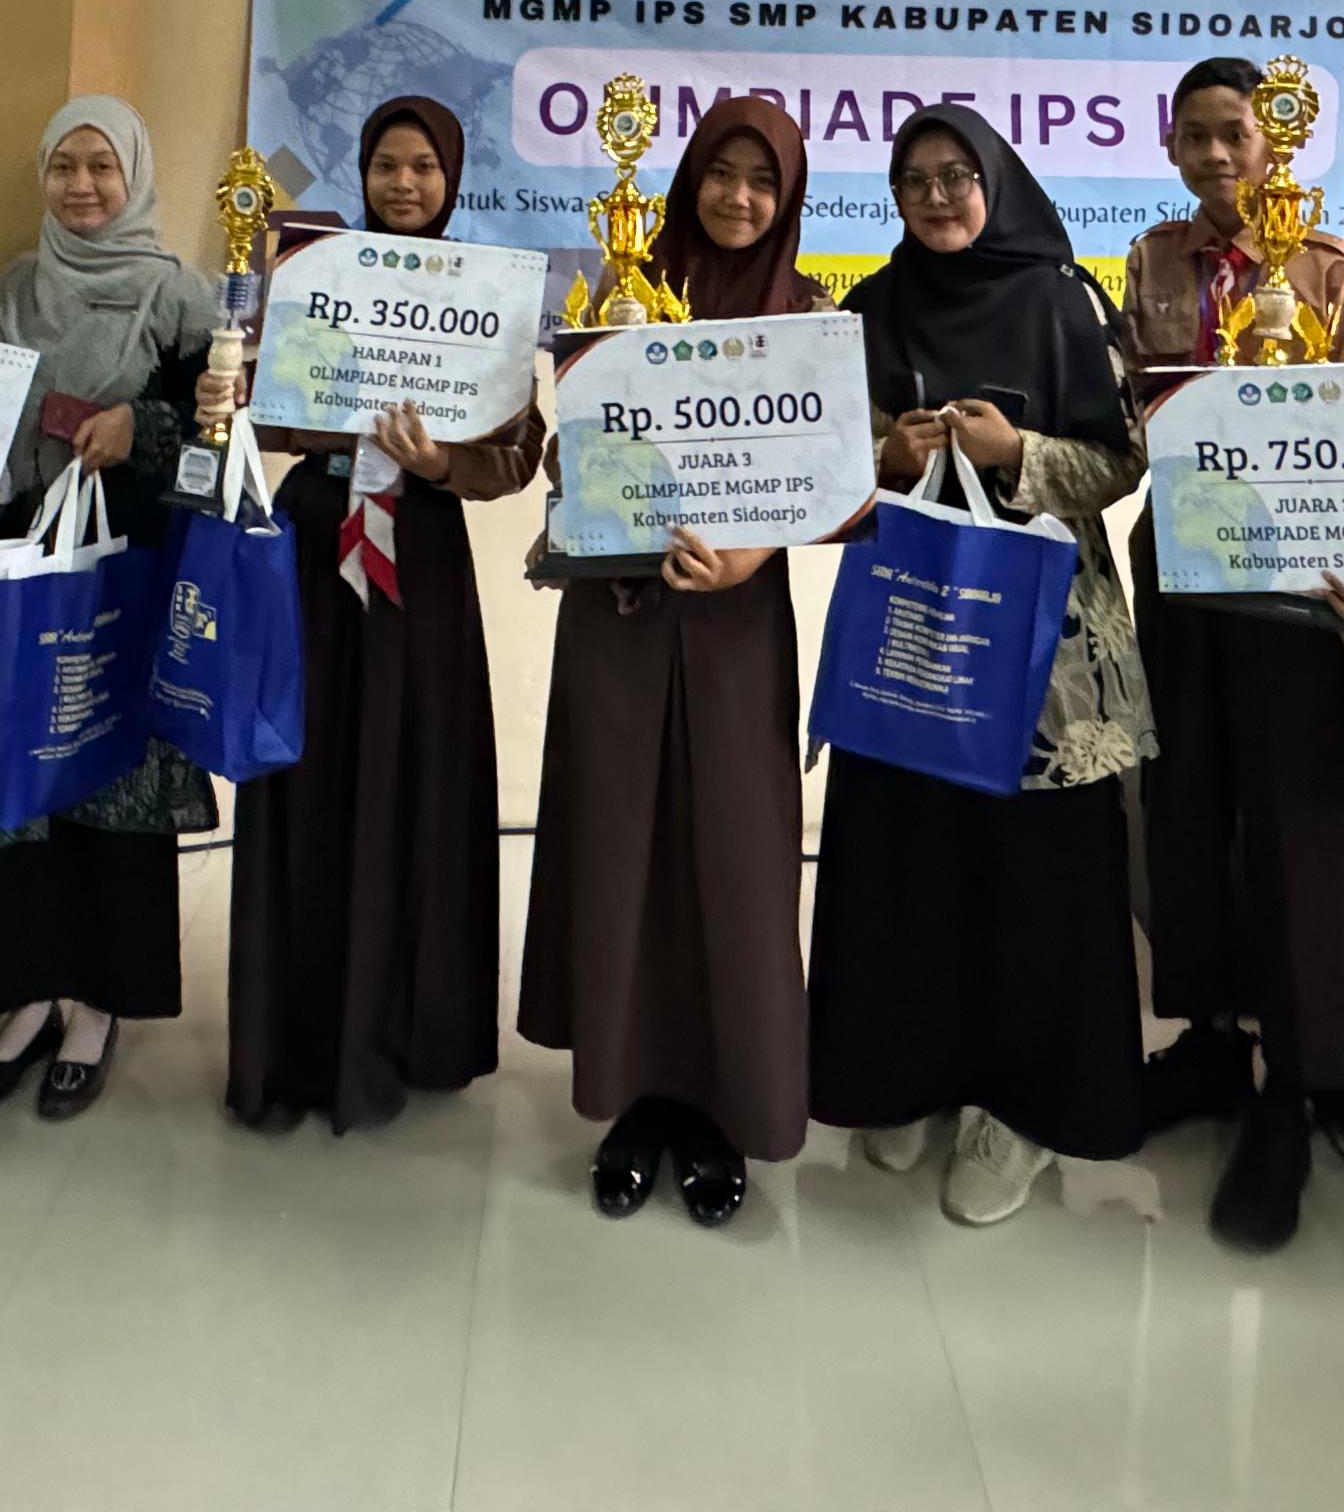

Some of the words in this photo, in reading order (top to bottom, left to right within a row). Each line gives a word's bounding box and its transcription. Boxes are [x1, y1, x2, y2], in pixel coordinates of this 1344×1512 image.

[636, 0, 705, 25] IPS
[729, 2, 816, 27] SMP
[841, 4, 1108, 35] KABUPATEN
[1011, 92, 1125, 147] IPS
[453, 187, 506, 212] ntuk
[801, 195, 901, 226] Sederaja
[306, 291, 360, 329] Rp.
[370, 299, 500, 338] 350.000
[352, 346, 433, 366] HARAPAN
[434, 354, 443, 368] 1
[309, 365, 398, 388] OLIMPIADE
[401, 375, 451, 393] MGMP
[452, 380, 479, 396] IPS
[601, 402, 663, 440] Rp.
[673, 391, 823, 430] 500.000
[677, 453, 738, 471] JUARA
[741, 451, 752, 467] 3
[1195, 441, 1260, 480] Rp.
[621, 480, 721, 500] OLIMPIADE
[724, 478, 782, 497] MGMP
[785, 476, 815, 493] IPS
[732, 504, 807, 525] Sidoarjo
[1274, 498, 1339, 514] JUARA
[1216, 526, 1321, 542] OLIMPIADE
[1228, 552, 1330, 571] Kabupaten
